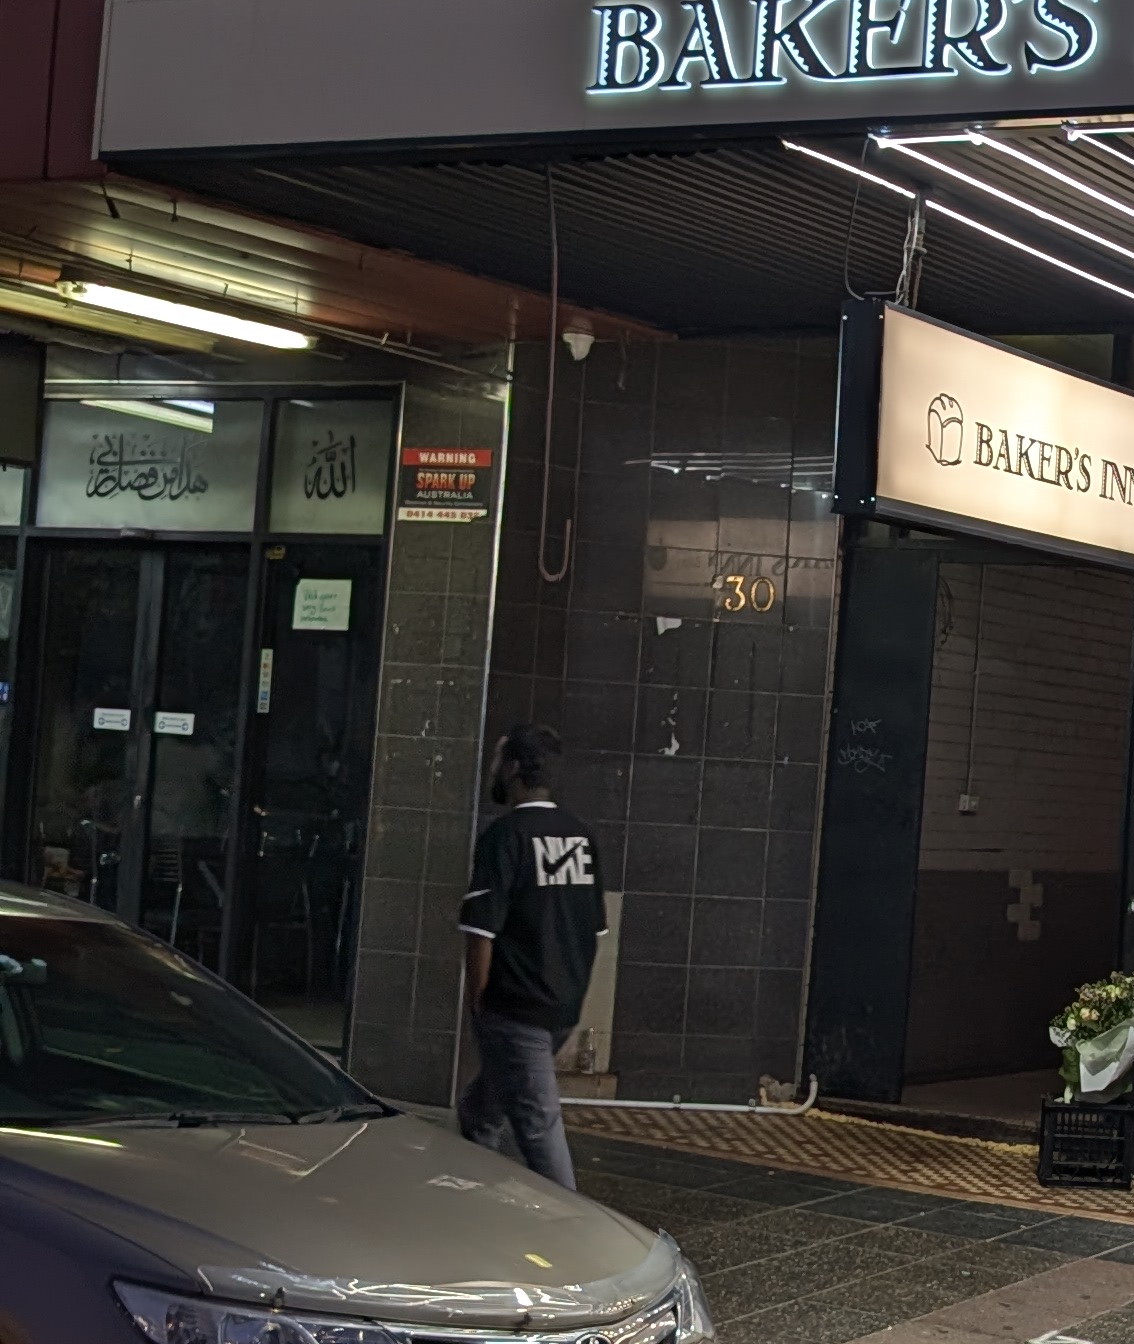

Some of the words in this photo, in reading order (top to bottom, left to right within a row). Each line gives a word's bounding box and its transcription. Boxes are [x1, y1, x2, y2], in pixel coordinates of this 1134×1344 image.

[419, 452, 476, 464] WARNING
[973, 422, 1092, 493] BAKER'S
[416, 473, 456, 489] SPARK
[459, 473, 476, 490] UP
[416, 490, 473, 499] AUSTRALIA
[724, 576, 775, 612] 30
